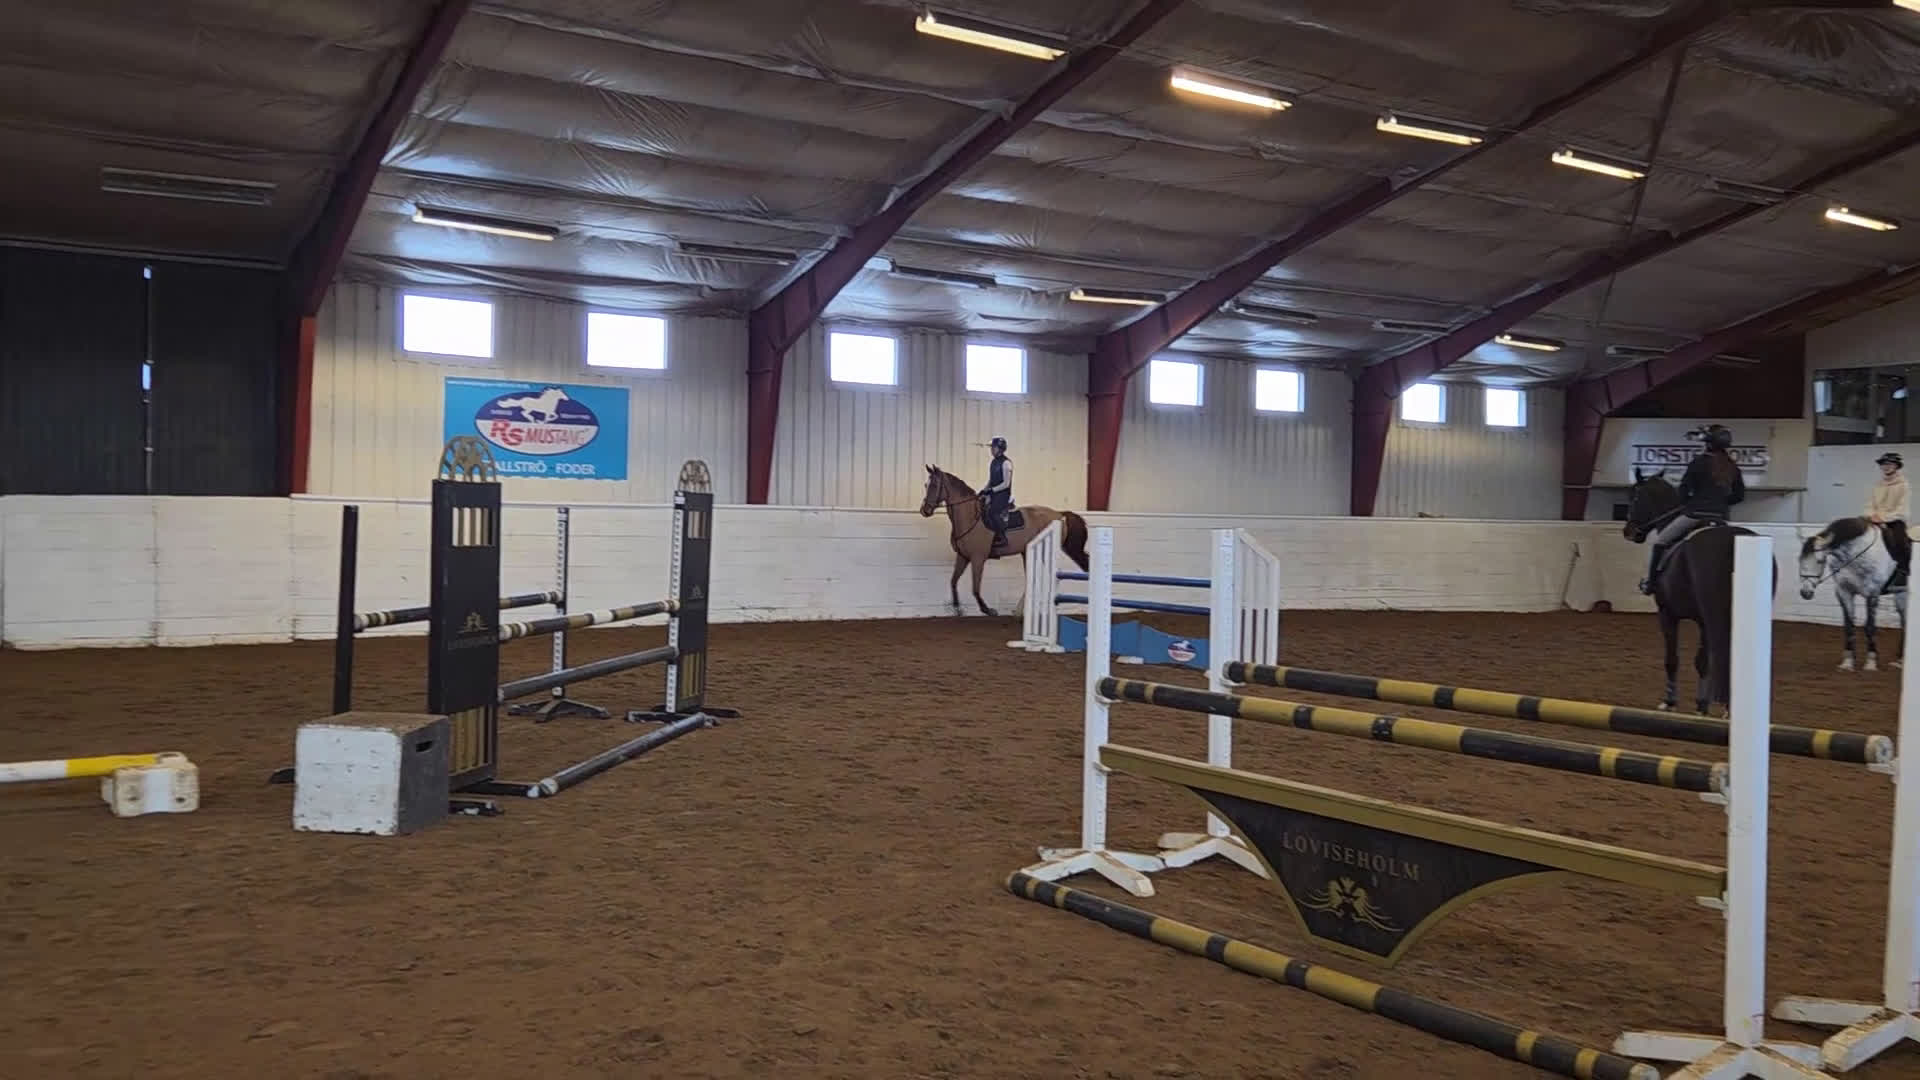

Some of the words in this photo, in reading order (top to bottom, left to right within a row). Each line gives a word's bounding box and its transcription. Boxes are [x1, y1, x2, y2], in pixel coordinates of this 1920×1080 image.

[525, 426, 586, 447] MUSTANG
[1636, 446, 1769, 465] TORSTONS
[555, 462, 596, 475] FODER
[1282, 831, 1421, 881] LOVISEHOLM
